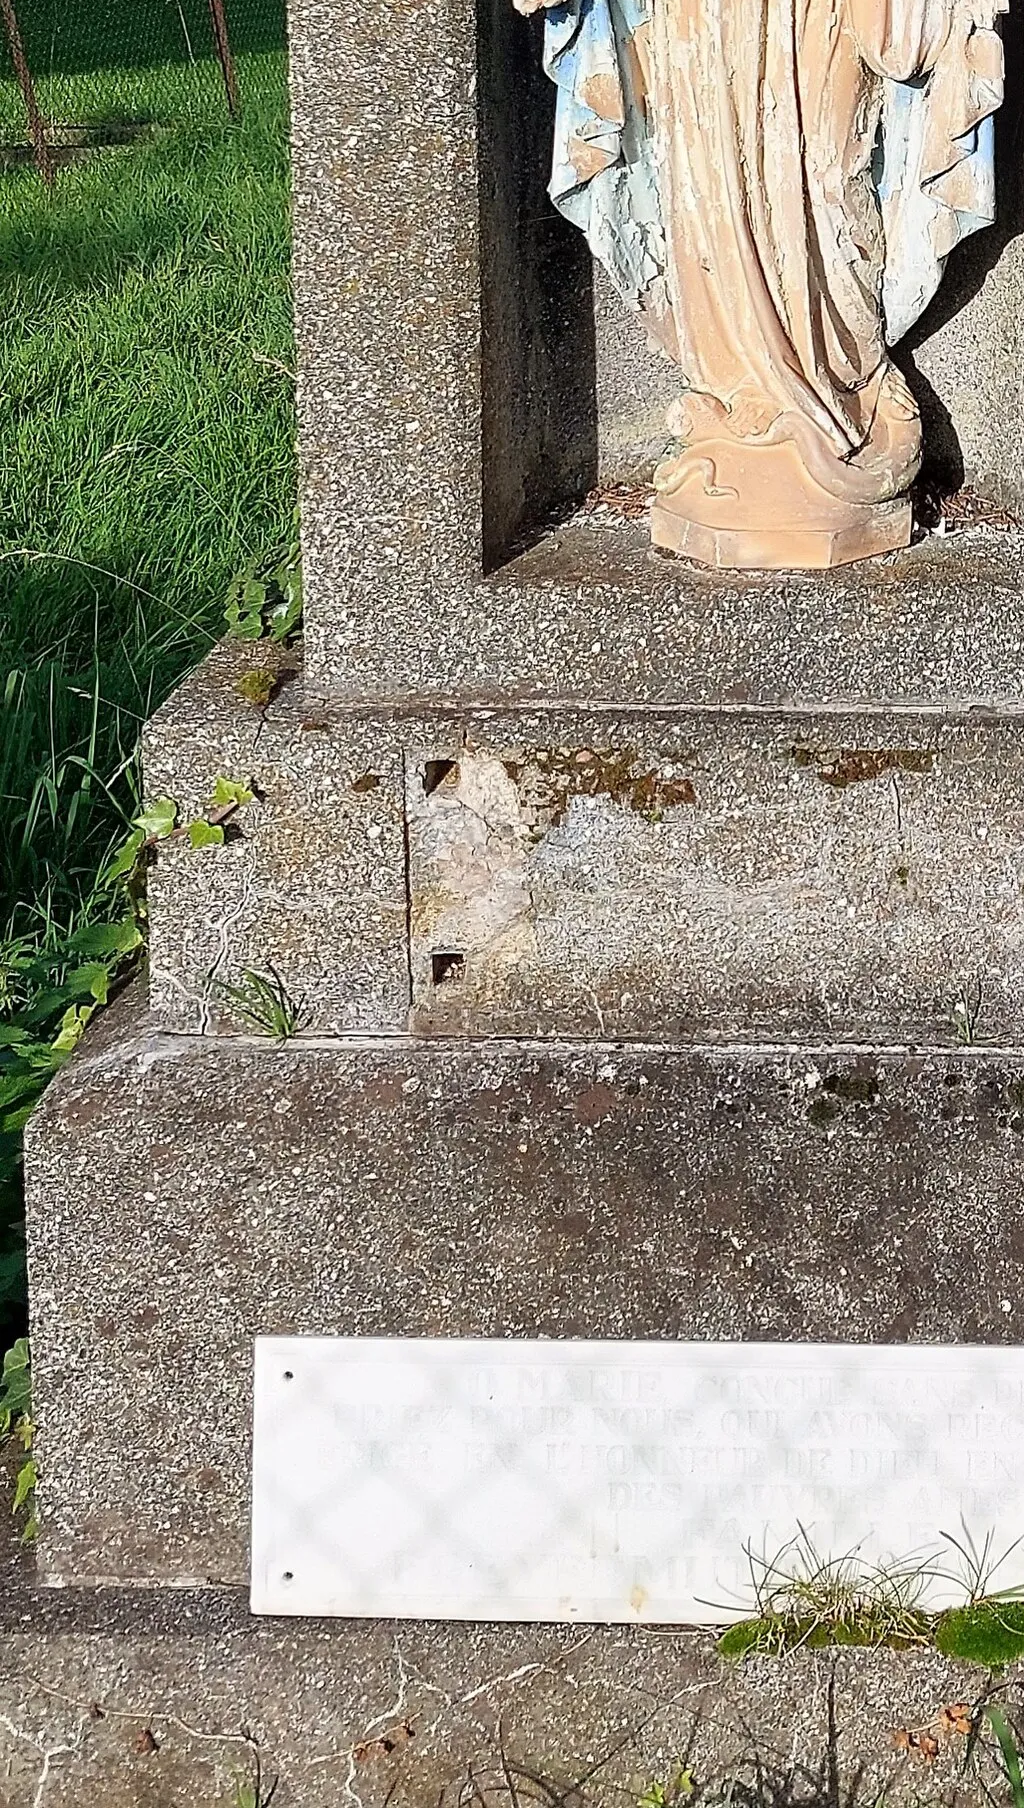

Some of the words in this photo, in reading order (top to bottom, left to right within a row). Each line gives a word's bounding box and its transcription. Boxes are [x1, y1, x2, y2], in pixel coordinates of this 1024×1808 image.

[468, 1405, 575, 1437] POUR
[720, 1408, 784, 1441] QUI
[807, 1409, 928, 1442] AVONS
[544, 1441, 763, 1476] L'HONNEUR
[783, 1446, 834, 1478] DE
[849, 1447, 941, 1480] DIEU
[964, 1449, 1017, 1482] EN
[606, 1482, 684, 1514] DES
